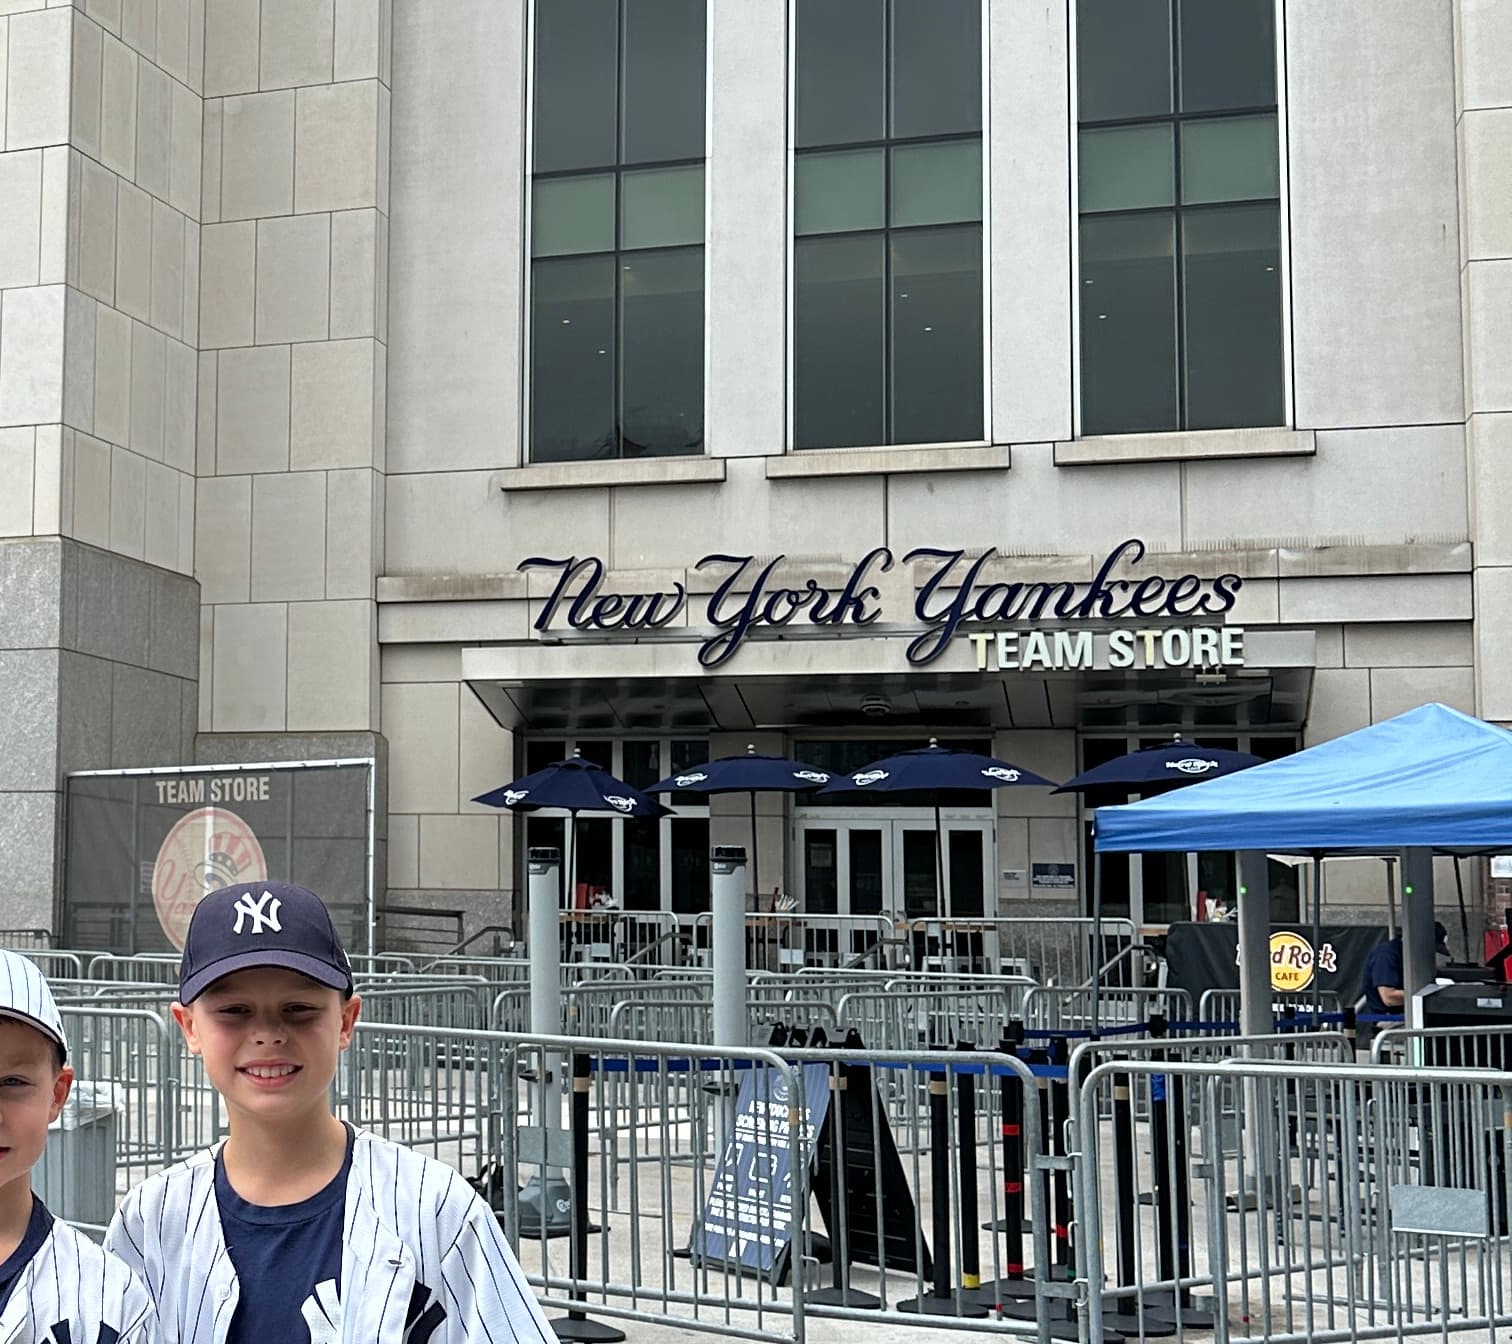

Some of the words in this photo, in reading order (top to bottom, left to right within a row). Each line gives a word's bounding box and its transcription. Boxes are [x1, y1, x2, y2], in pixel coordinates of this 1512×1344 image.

[517, 554, 687, 633] New
[695, 546, 894, 668] York
[902, 538, 1245, 667] Yankees
[968, 629, 1094, 672] TEAM
[1108, 626, 1245, 669] STORE
[156, 778, 205, 804] TEAM
[210, 777, 270, 802] STORE
[233, 890, 282, 935] NY
[1289, 944, 1336, 971] Rok
[1275, 972, 1299, 981] CAFE
